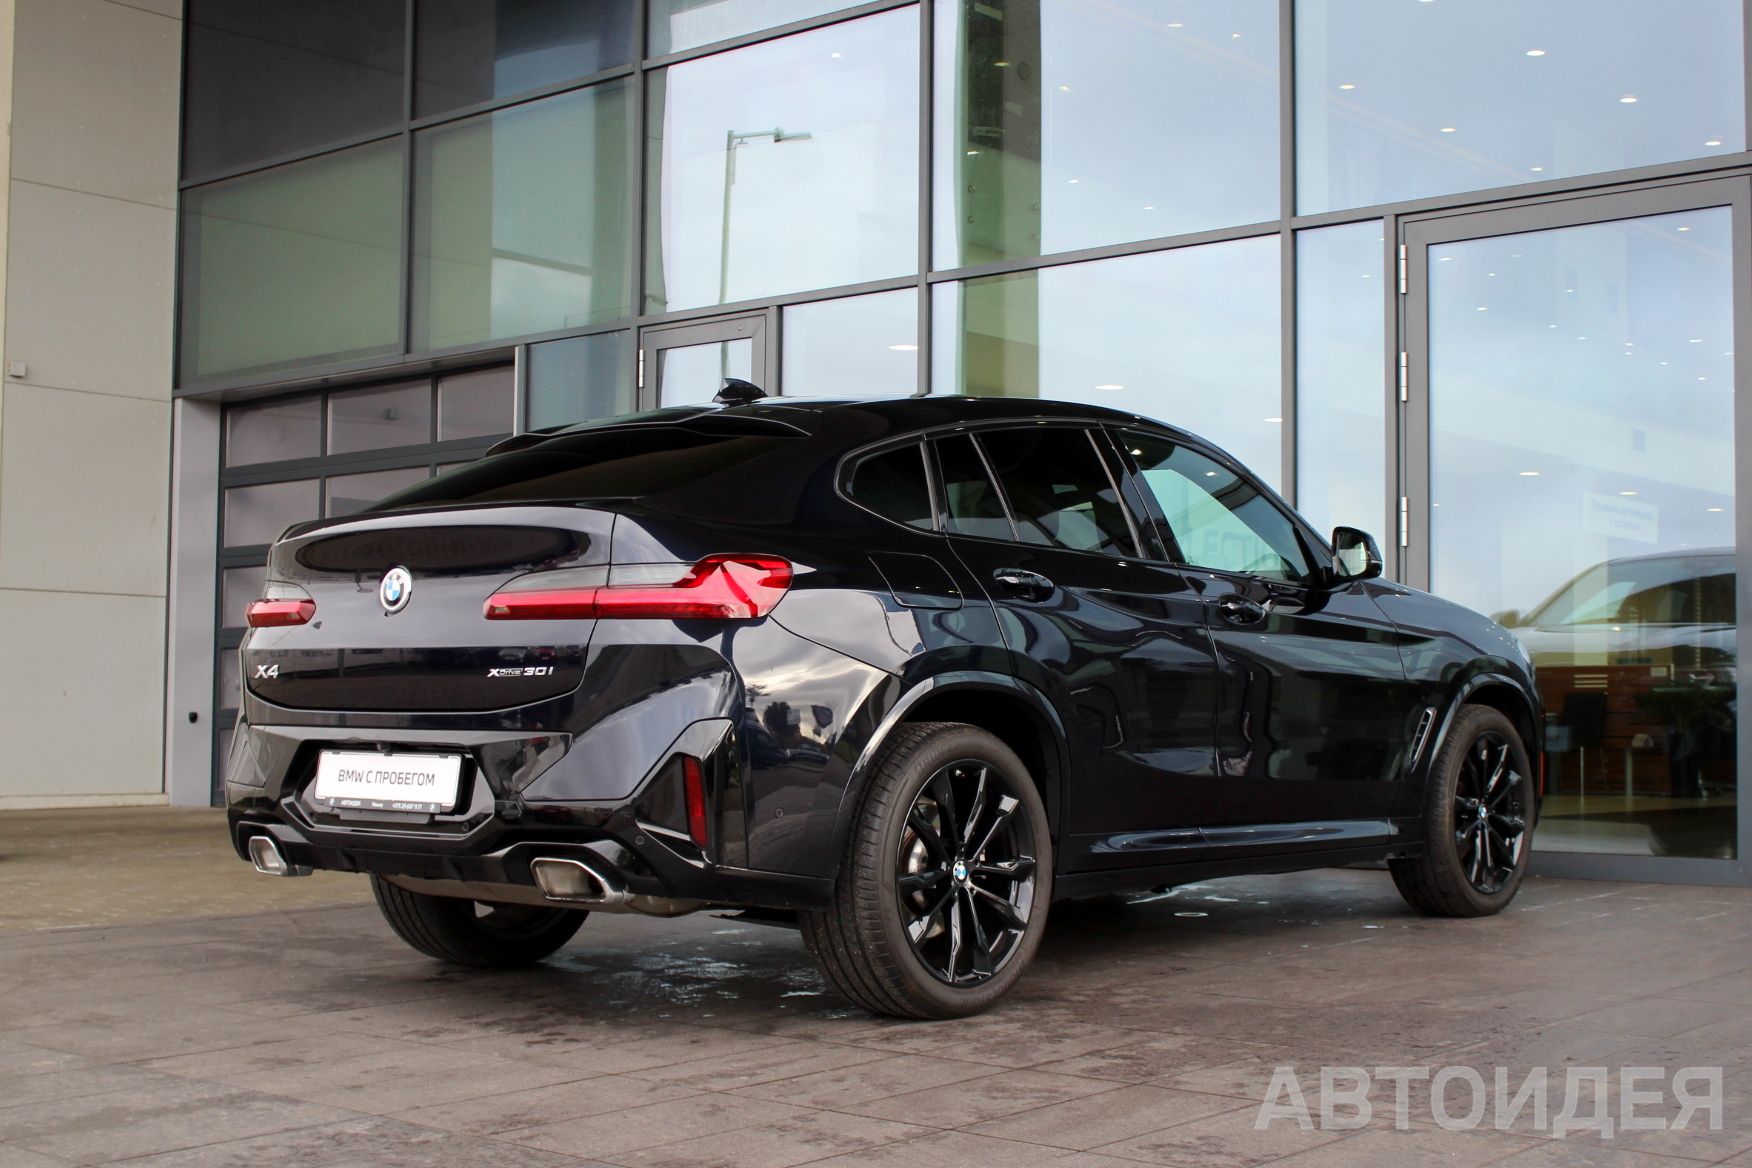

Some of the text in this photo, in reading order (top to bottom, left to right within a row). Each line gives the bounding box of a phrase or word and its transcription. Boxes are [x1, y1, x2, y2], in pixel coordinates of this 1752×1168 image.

[255, 665, 279, 679] X4
[338, 769, 435, 786] BMW С ПРОБЕГОМ
